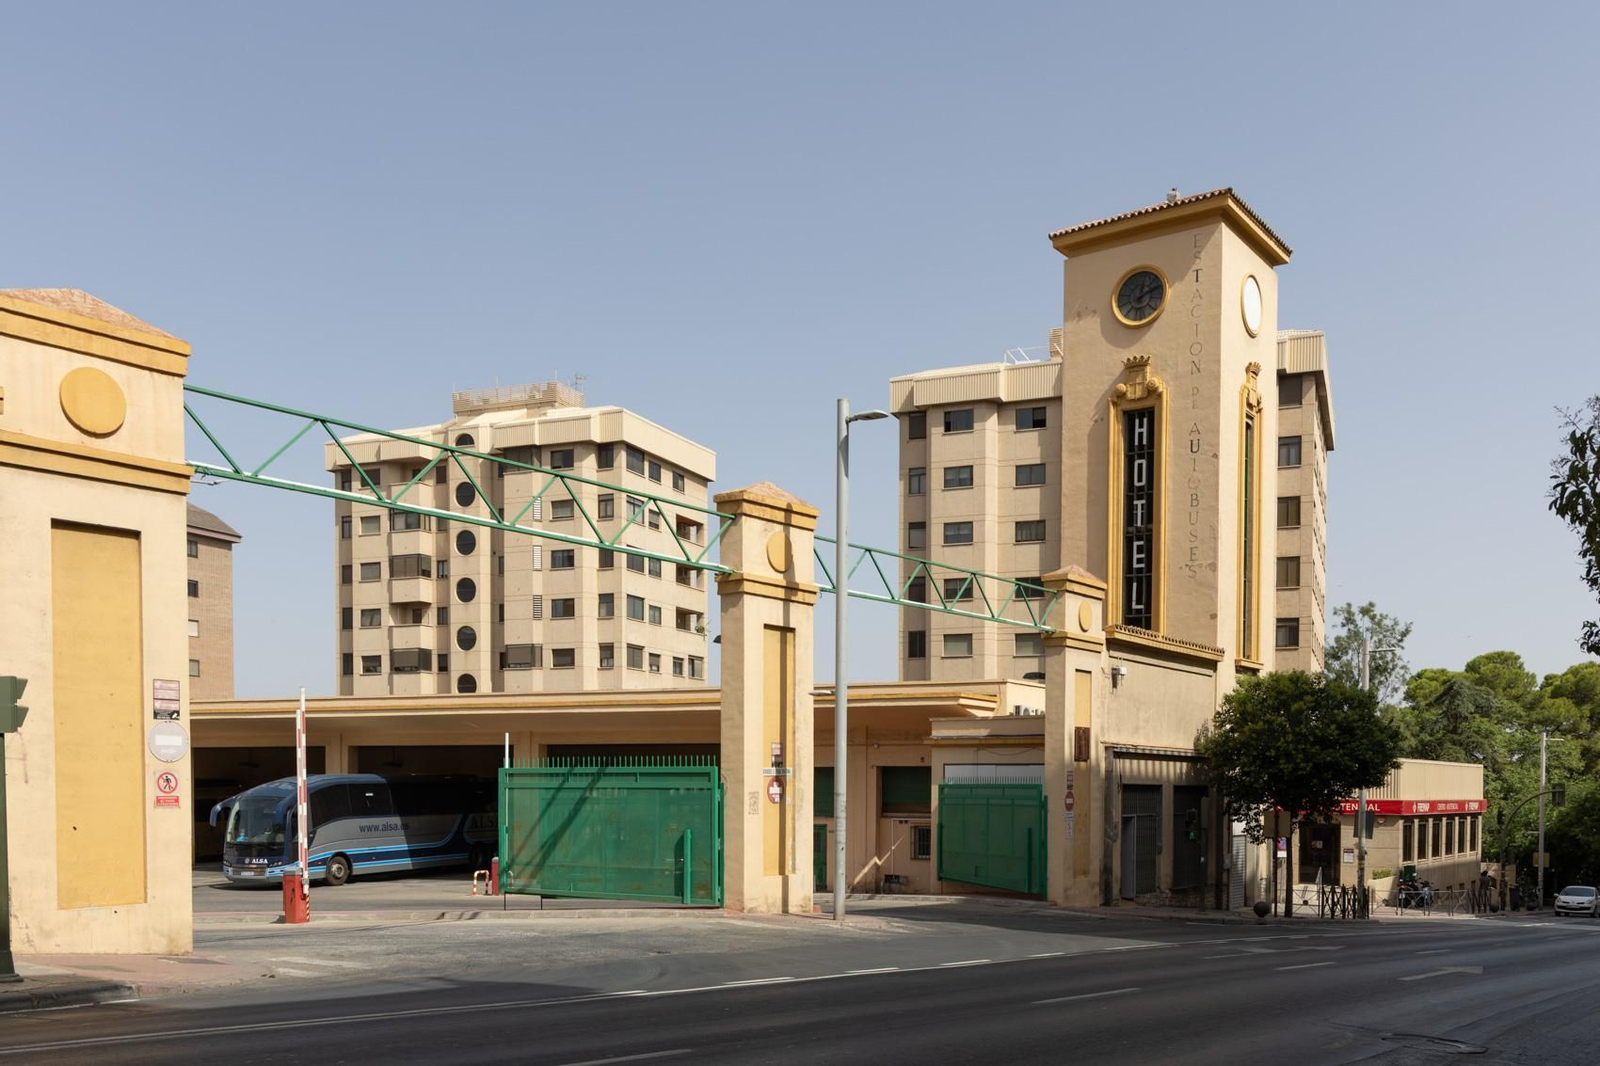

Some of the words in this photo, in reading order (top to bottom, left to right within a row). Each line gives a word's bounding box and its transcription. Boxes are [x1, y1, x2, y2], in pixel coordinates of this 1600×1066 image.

[1189, 233, 1203, 375] ESTACION
[1131, 417, 1147, 609] HOTEL
[359, 821, 409, 833] www.alsa.es
